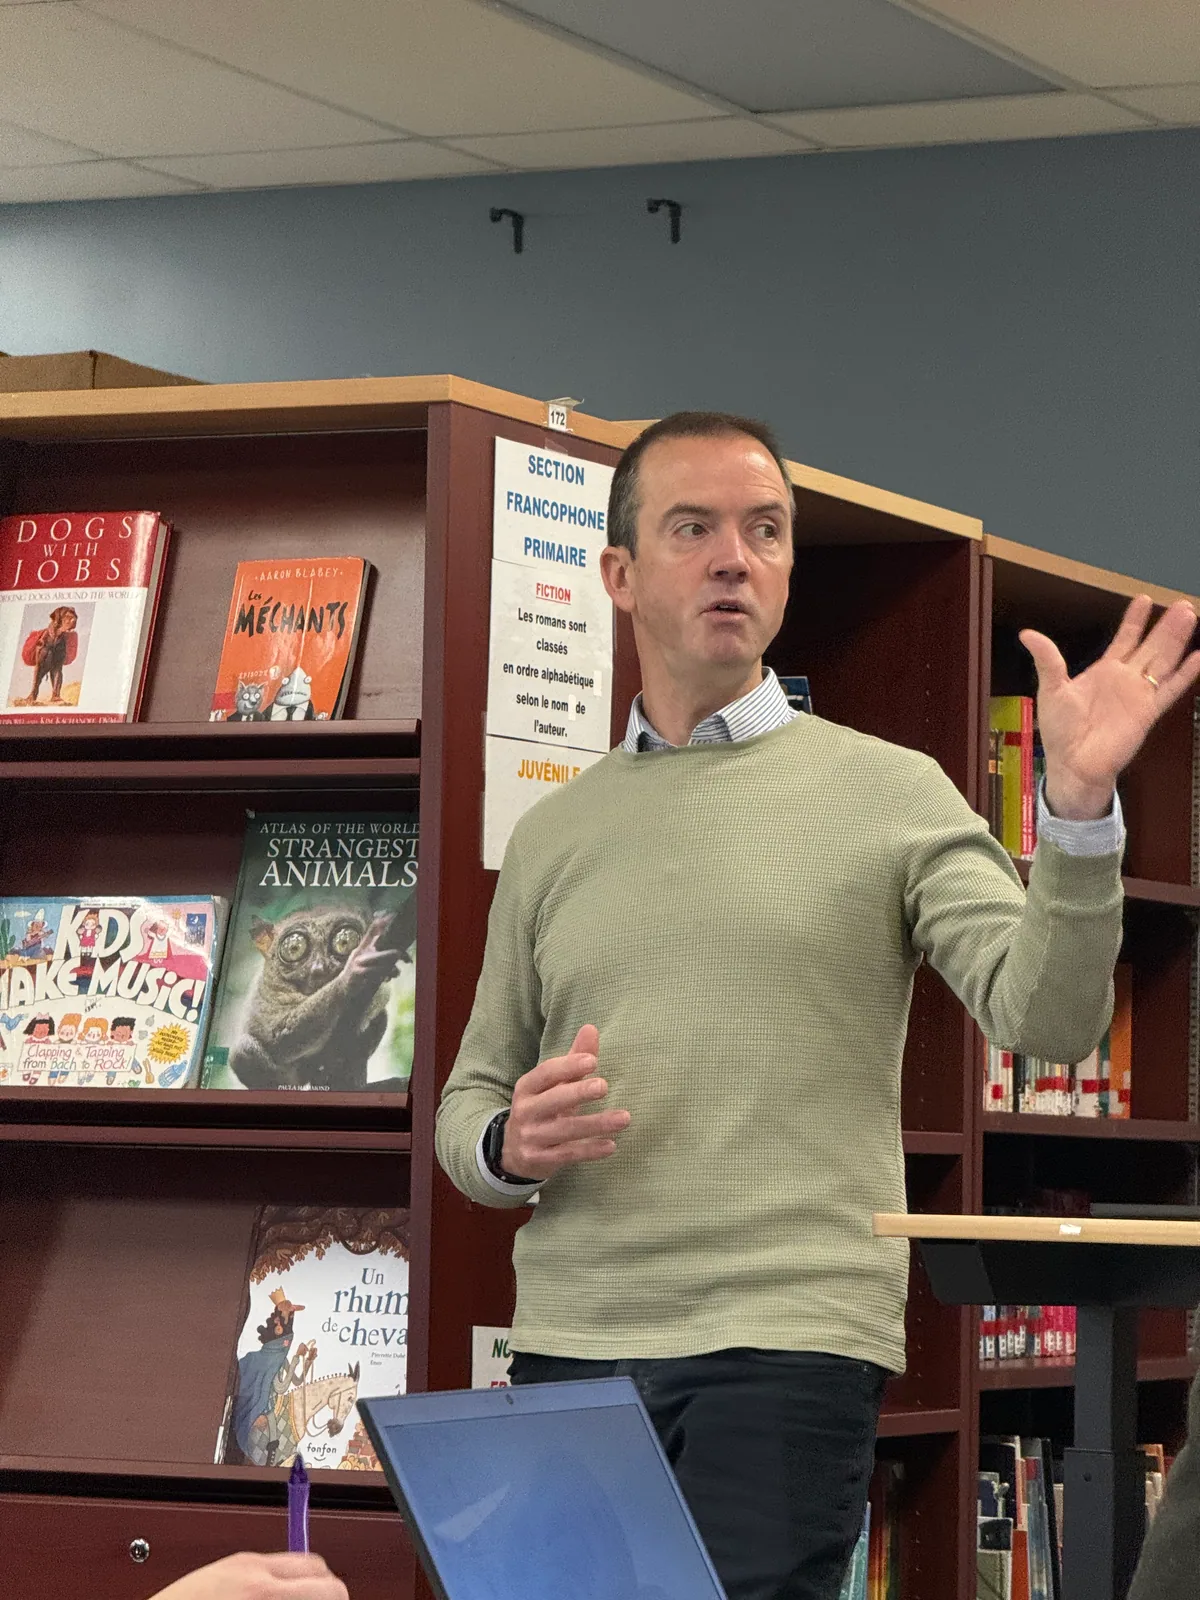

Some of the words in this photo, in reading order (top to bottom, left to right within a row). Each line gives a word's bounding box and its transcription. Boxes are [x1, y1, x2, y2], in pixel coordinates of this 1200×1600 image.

[550, 410, 566, 426] 172
[528, 454, 585, 486] SECTION
[507, 491, 605, 531] FRANCOPHONE
[17, 516, 133, 543] DOGS
[44, 543, 99, 557] WITH
[524, 536, 587, 568] PRIMAIRE
[13, 558, 121, 588] JOBS
[260, 568, 291, 581] AARON
[295, 567, 339, 579] BLABEY
[53, 590, 89, 601] AROUND
[248, 590, 262, 601] Les
[536, 582, 572, 602] FICTION
[234, 596, 349, 640] MÉCHANTS
[518, 607, 534, 624] Les
[535, 613, 567, 630] romans
[568, 619, 587, 634] sont
[536, 637, 568, 656] classés
[503, 661, 515, 674] en
[516, 664, 540, 680] ordre
[541, 668, 595, 690] alphabétique
[516, 692, 541, 709] selon
[541, 694, 549, 710] le
[551, 699, 569, 712] nom
[575, 699, 587, 715] de
[534, 719, 568, 737] l'auteur.
[259, 822, 307, 835] ATLAS
[311, 822, 332, 835] OF
[335, 822, 366, 835] THE
[266, 837, 420, 859] STRANGEST
[258, 860, 419, 888] ANIMALS
[27, 1044, 72, 1061] Clapping
[85, 1045, 125, 1062] Tapping
[23, 1057, 47, 1070] from
[50, 1056, 77, 1071] Bach
[80, 1059, 90, 1070] to
[361, 1267, 385, 1286] Un
[321, 1316, 339, 1333] de
[306, 1443, 337, 1457] fonfon
